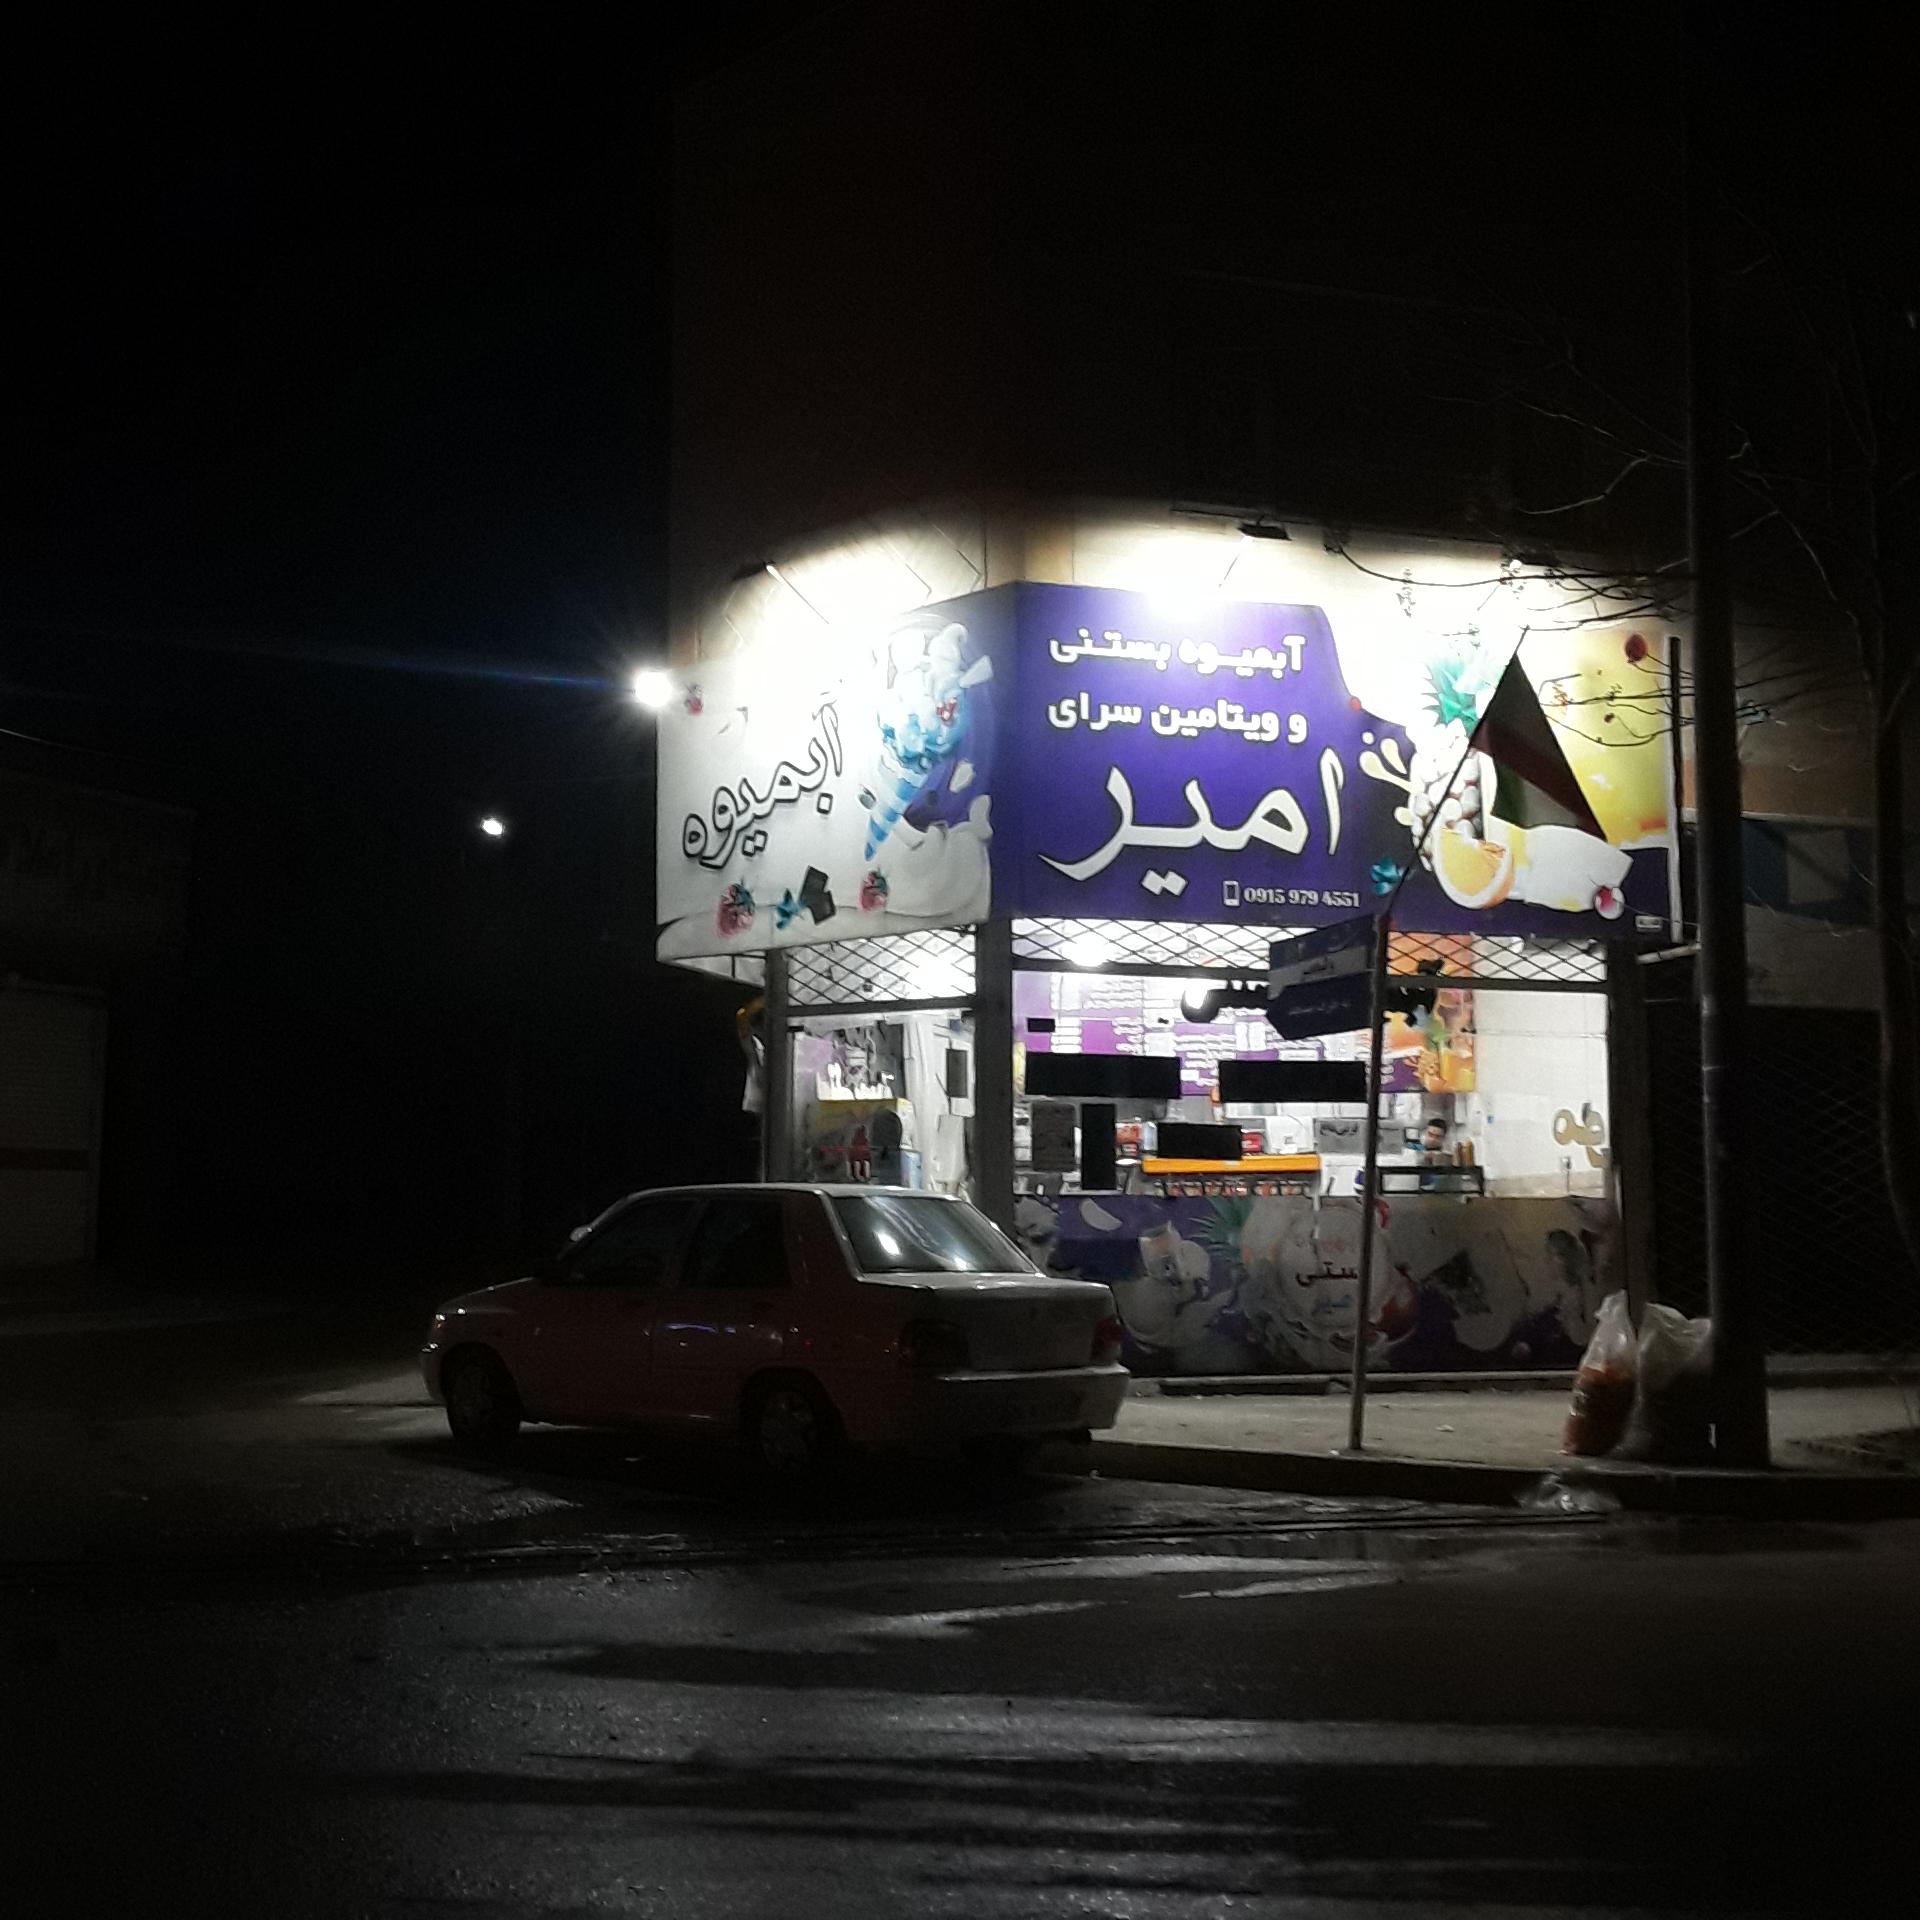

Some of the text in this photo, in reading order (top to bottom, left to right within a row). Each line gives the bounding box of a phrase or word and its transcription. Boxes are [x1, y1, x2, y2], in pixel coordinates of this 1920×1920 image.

[1049, 627, 1306, 679] آبمیوه بستنی
[1048, 692, 1308, 744] و ویتامین سرای
[1038, 746, 1345, 896] امیر
[1243, 886, 1361, 908] 0915 979 4551
